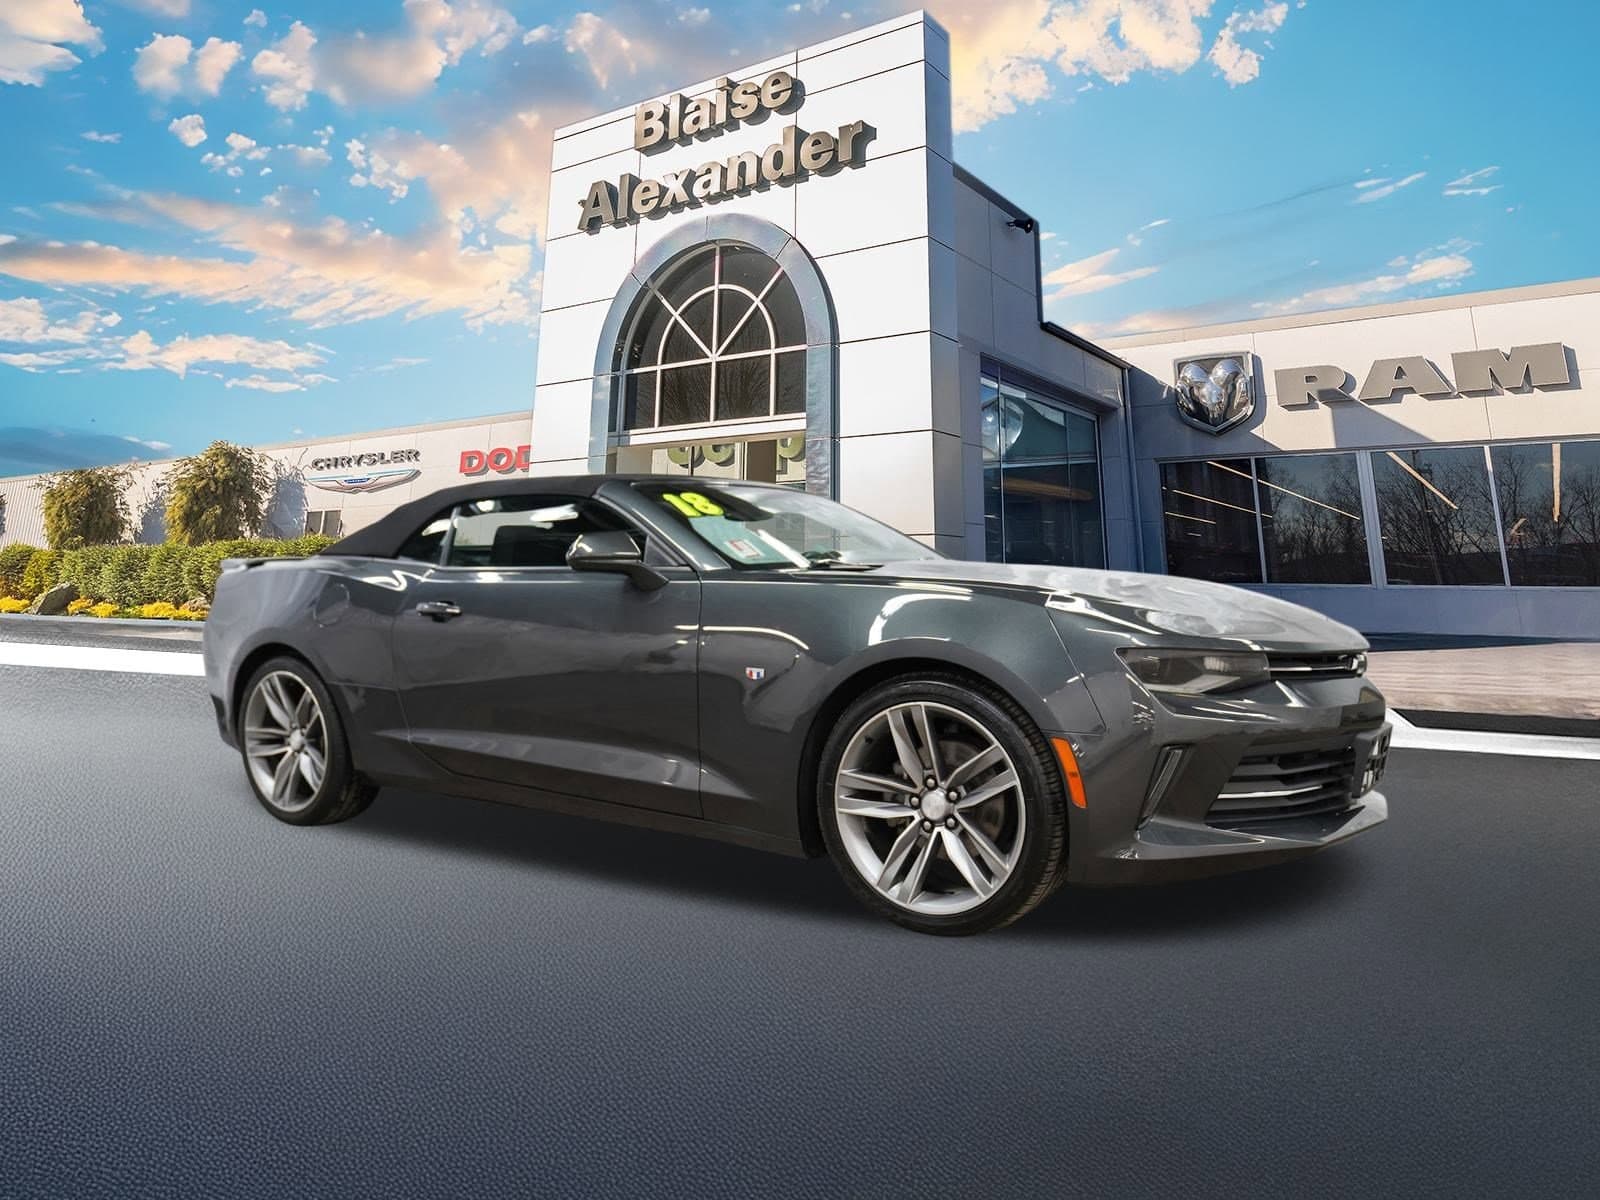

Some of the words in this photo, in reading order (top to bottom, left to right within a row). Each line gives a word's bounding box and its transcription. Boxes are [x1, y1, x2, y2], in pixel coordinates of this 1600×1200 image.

[633, 71, 803, 156] Blaise
[577, 119, 876, 234] Alexander
[1274, 342, 1580, 411] RAM
[311, 448, 421, 471] CHRYSLER
